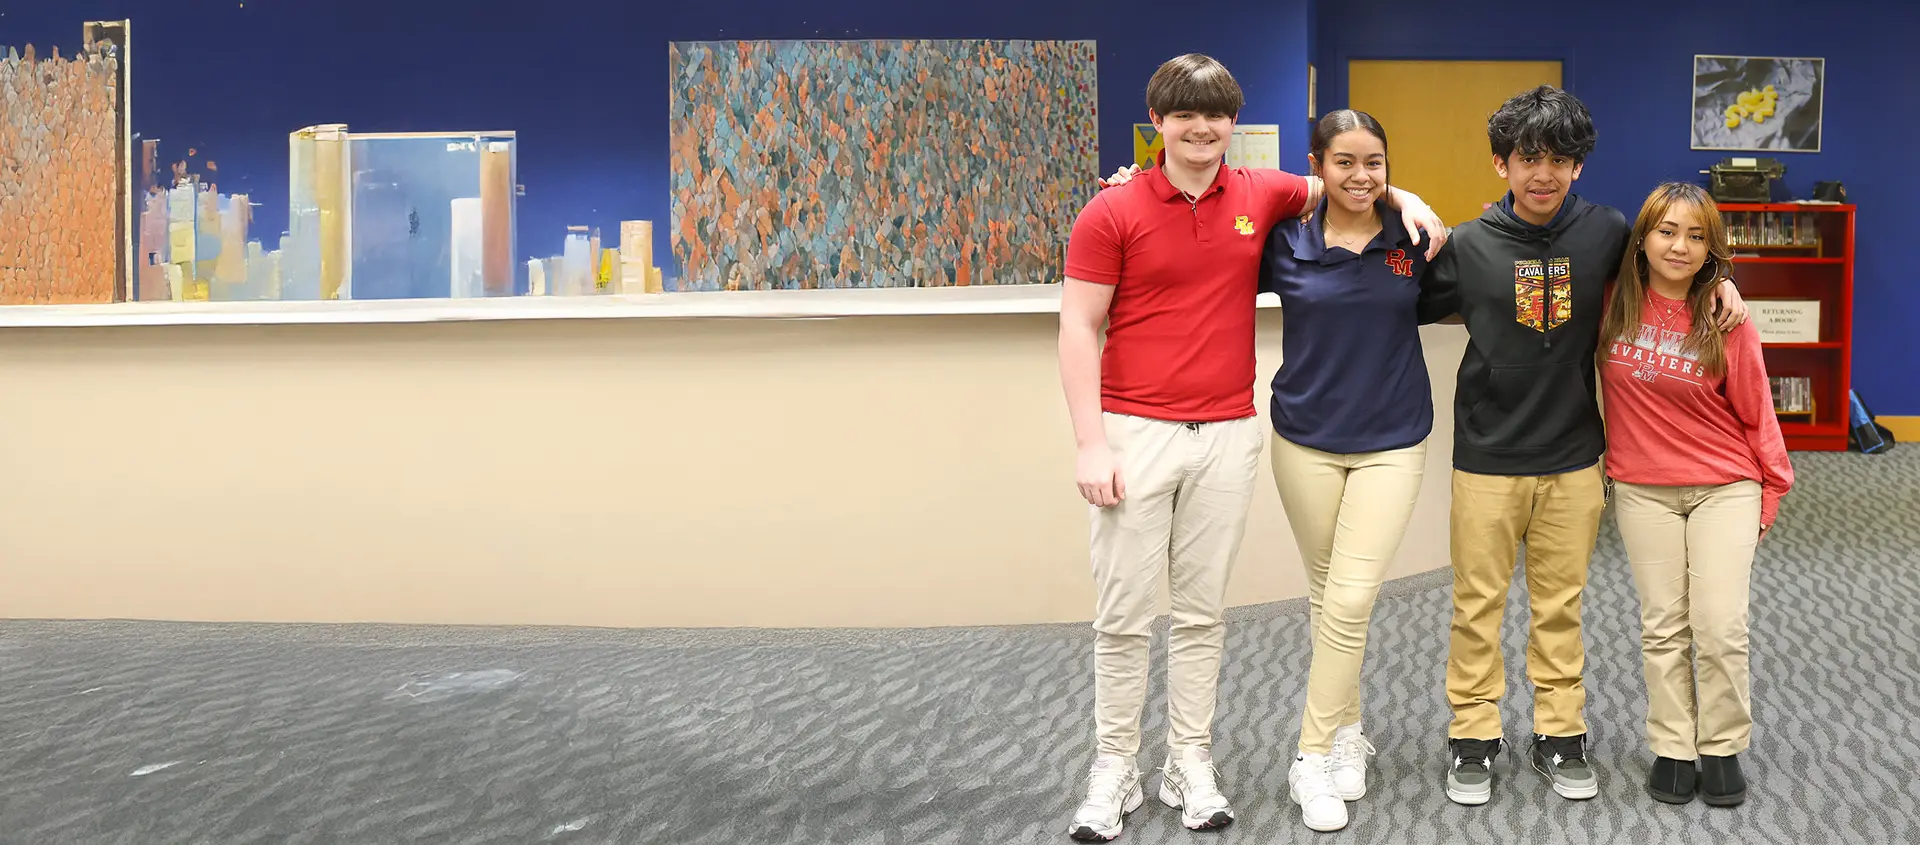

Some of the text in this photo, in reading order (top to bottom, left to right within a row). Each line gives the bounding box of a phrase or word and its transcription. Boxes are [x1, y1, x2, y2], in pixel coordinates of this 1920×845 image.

[1385, 249, 1413, 277] PM
[1518, 264, 1567, 277] CAVALERS
[1610, 343, 1705, 377] AVALIERS
